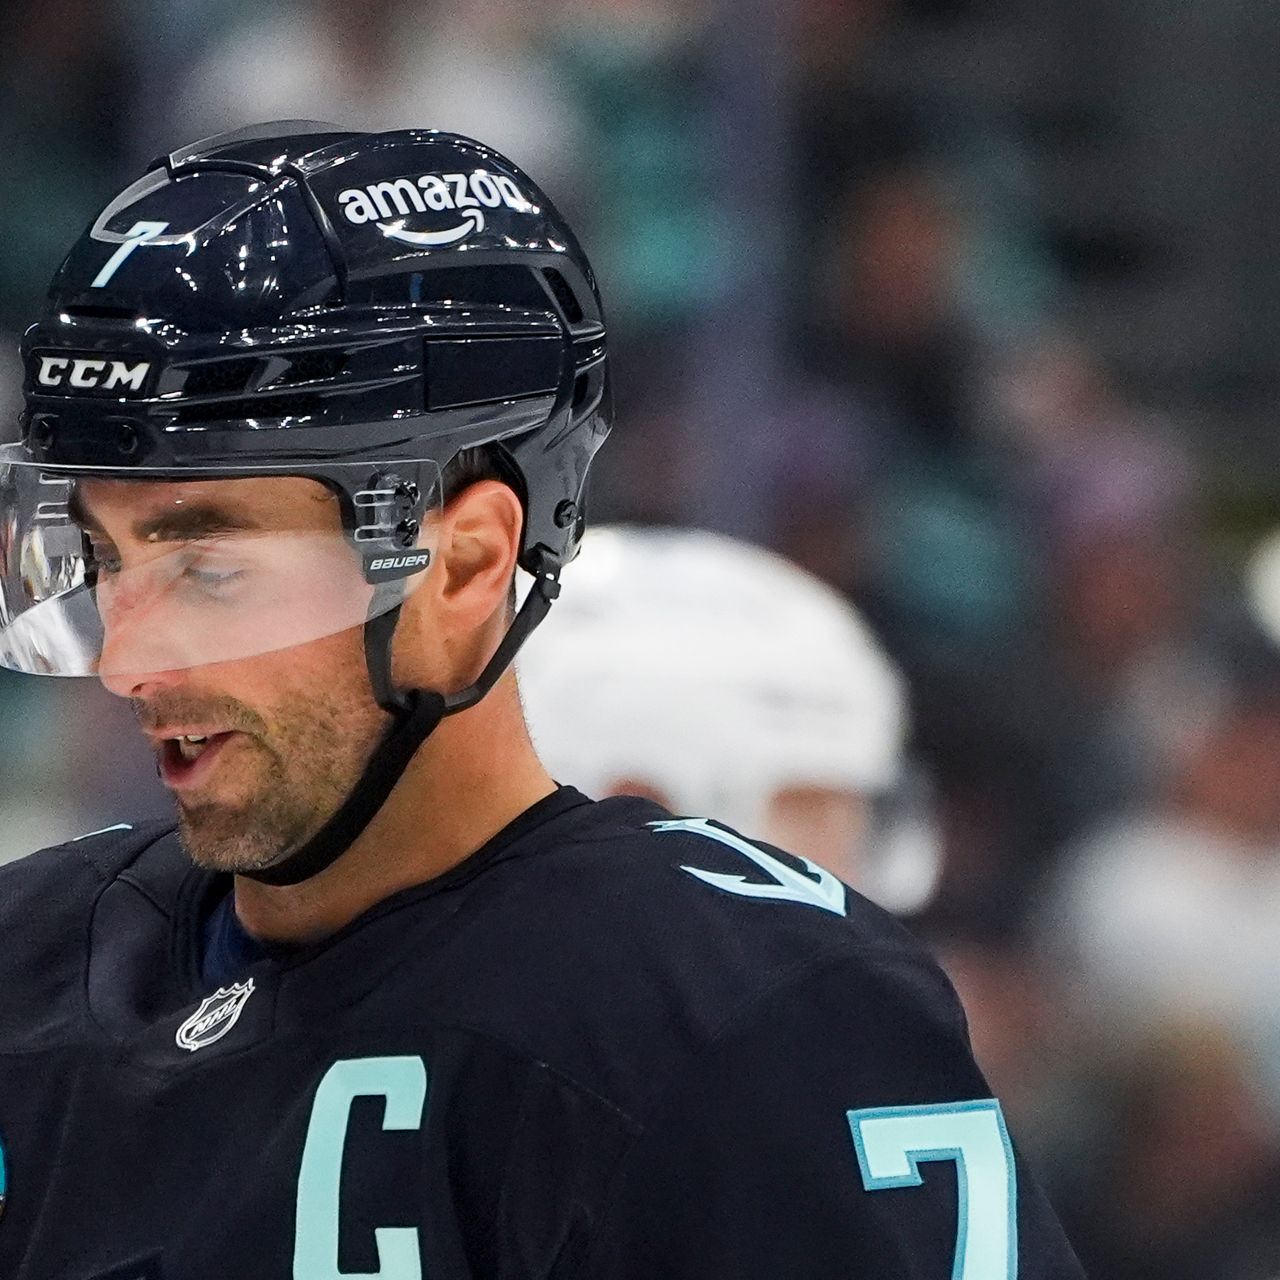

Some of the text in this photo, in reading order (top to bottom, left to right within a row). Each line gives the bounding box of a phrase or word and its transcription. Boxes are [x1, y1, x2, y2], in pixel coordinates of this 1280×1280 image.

[338, 171, 533, 224] amazon
[90, 221, 170, 287] 7
[38, 357, 150, 391] CCM
[370, 555, 428, 570] BAUER
